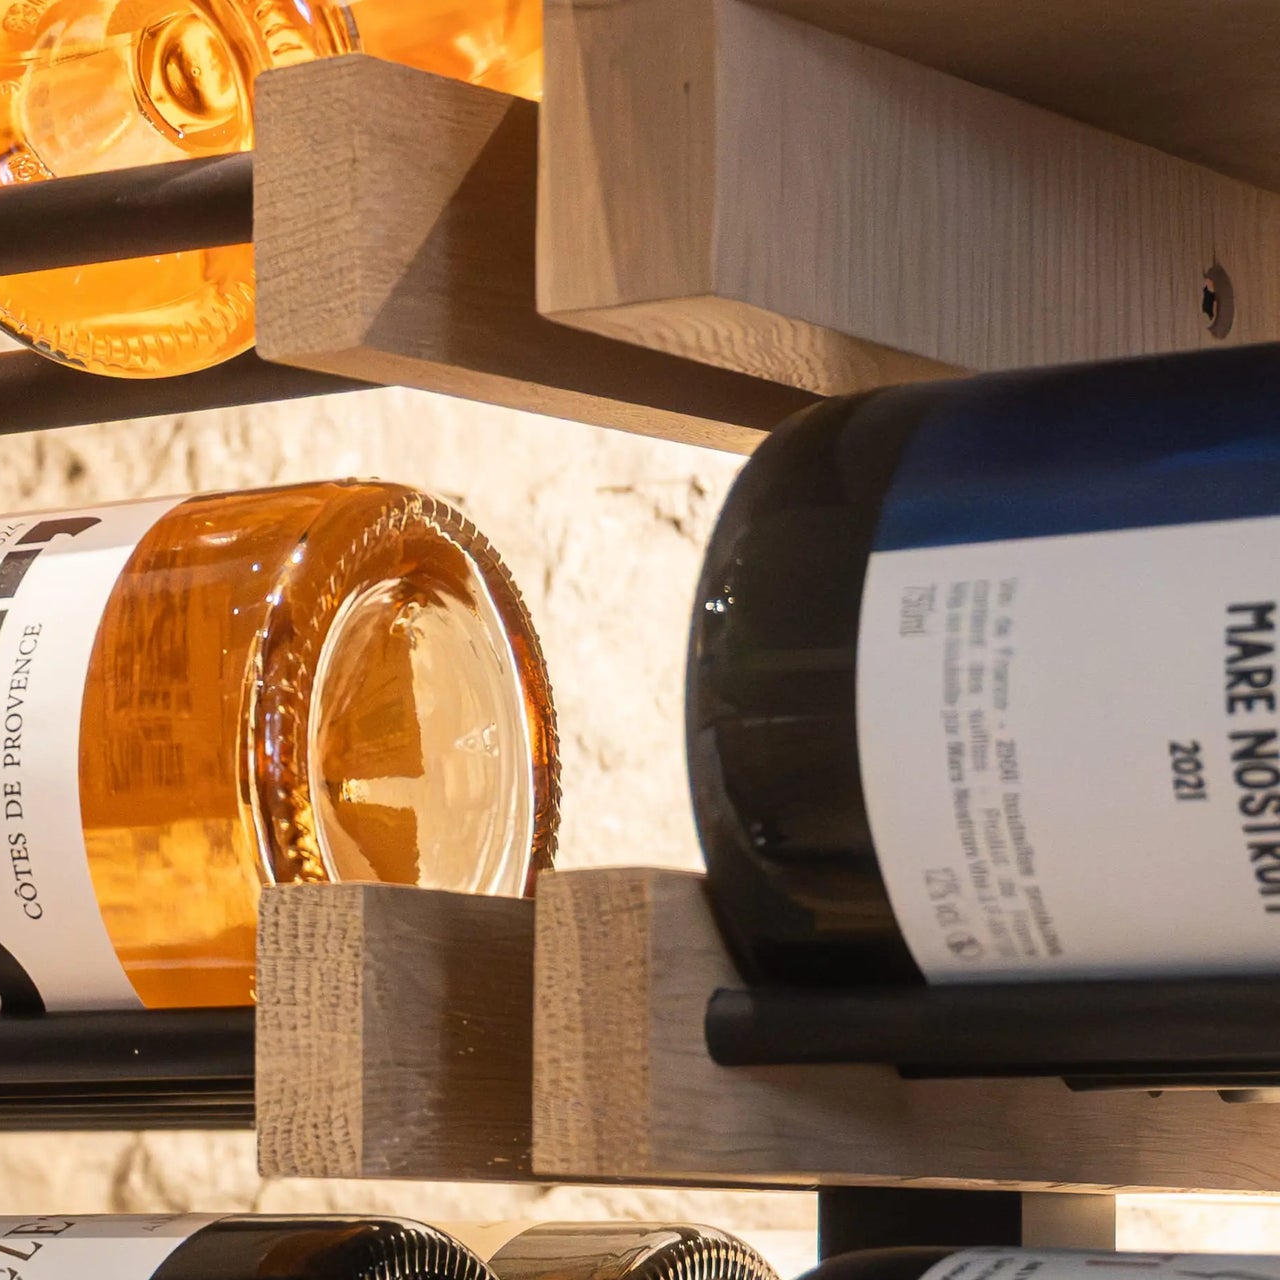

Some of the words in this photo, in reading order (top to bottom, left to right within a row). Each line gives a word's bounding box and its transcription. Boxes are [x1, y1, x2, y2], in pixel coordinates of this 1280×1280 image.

[4, 623, 43, 768] PROVENCE
[1225, 600, 1277, 715] MARE
[5, 781, 25, 821] DE
[1168, 739, 1208, 803] 2021
[7, 832, 44, 920] CÔTES
